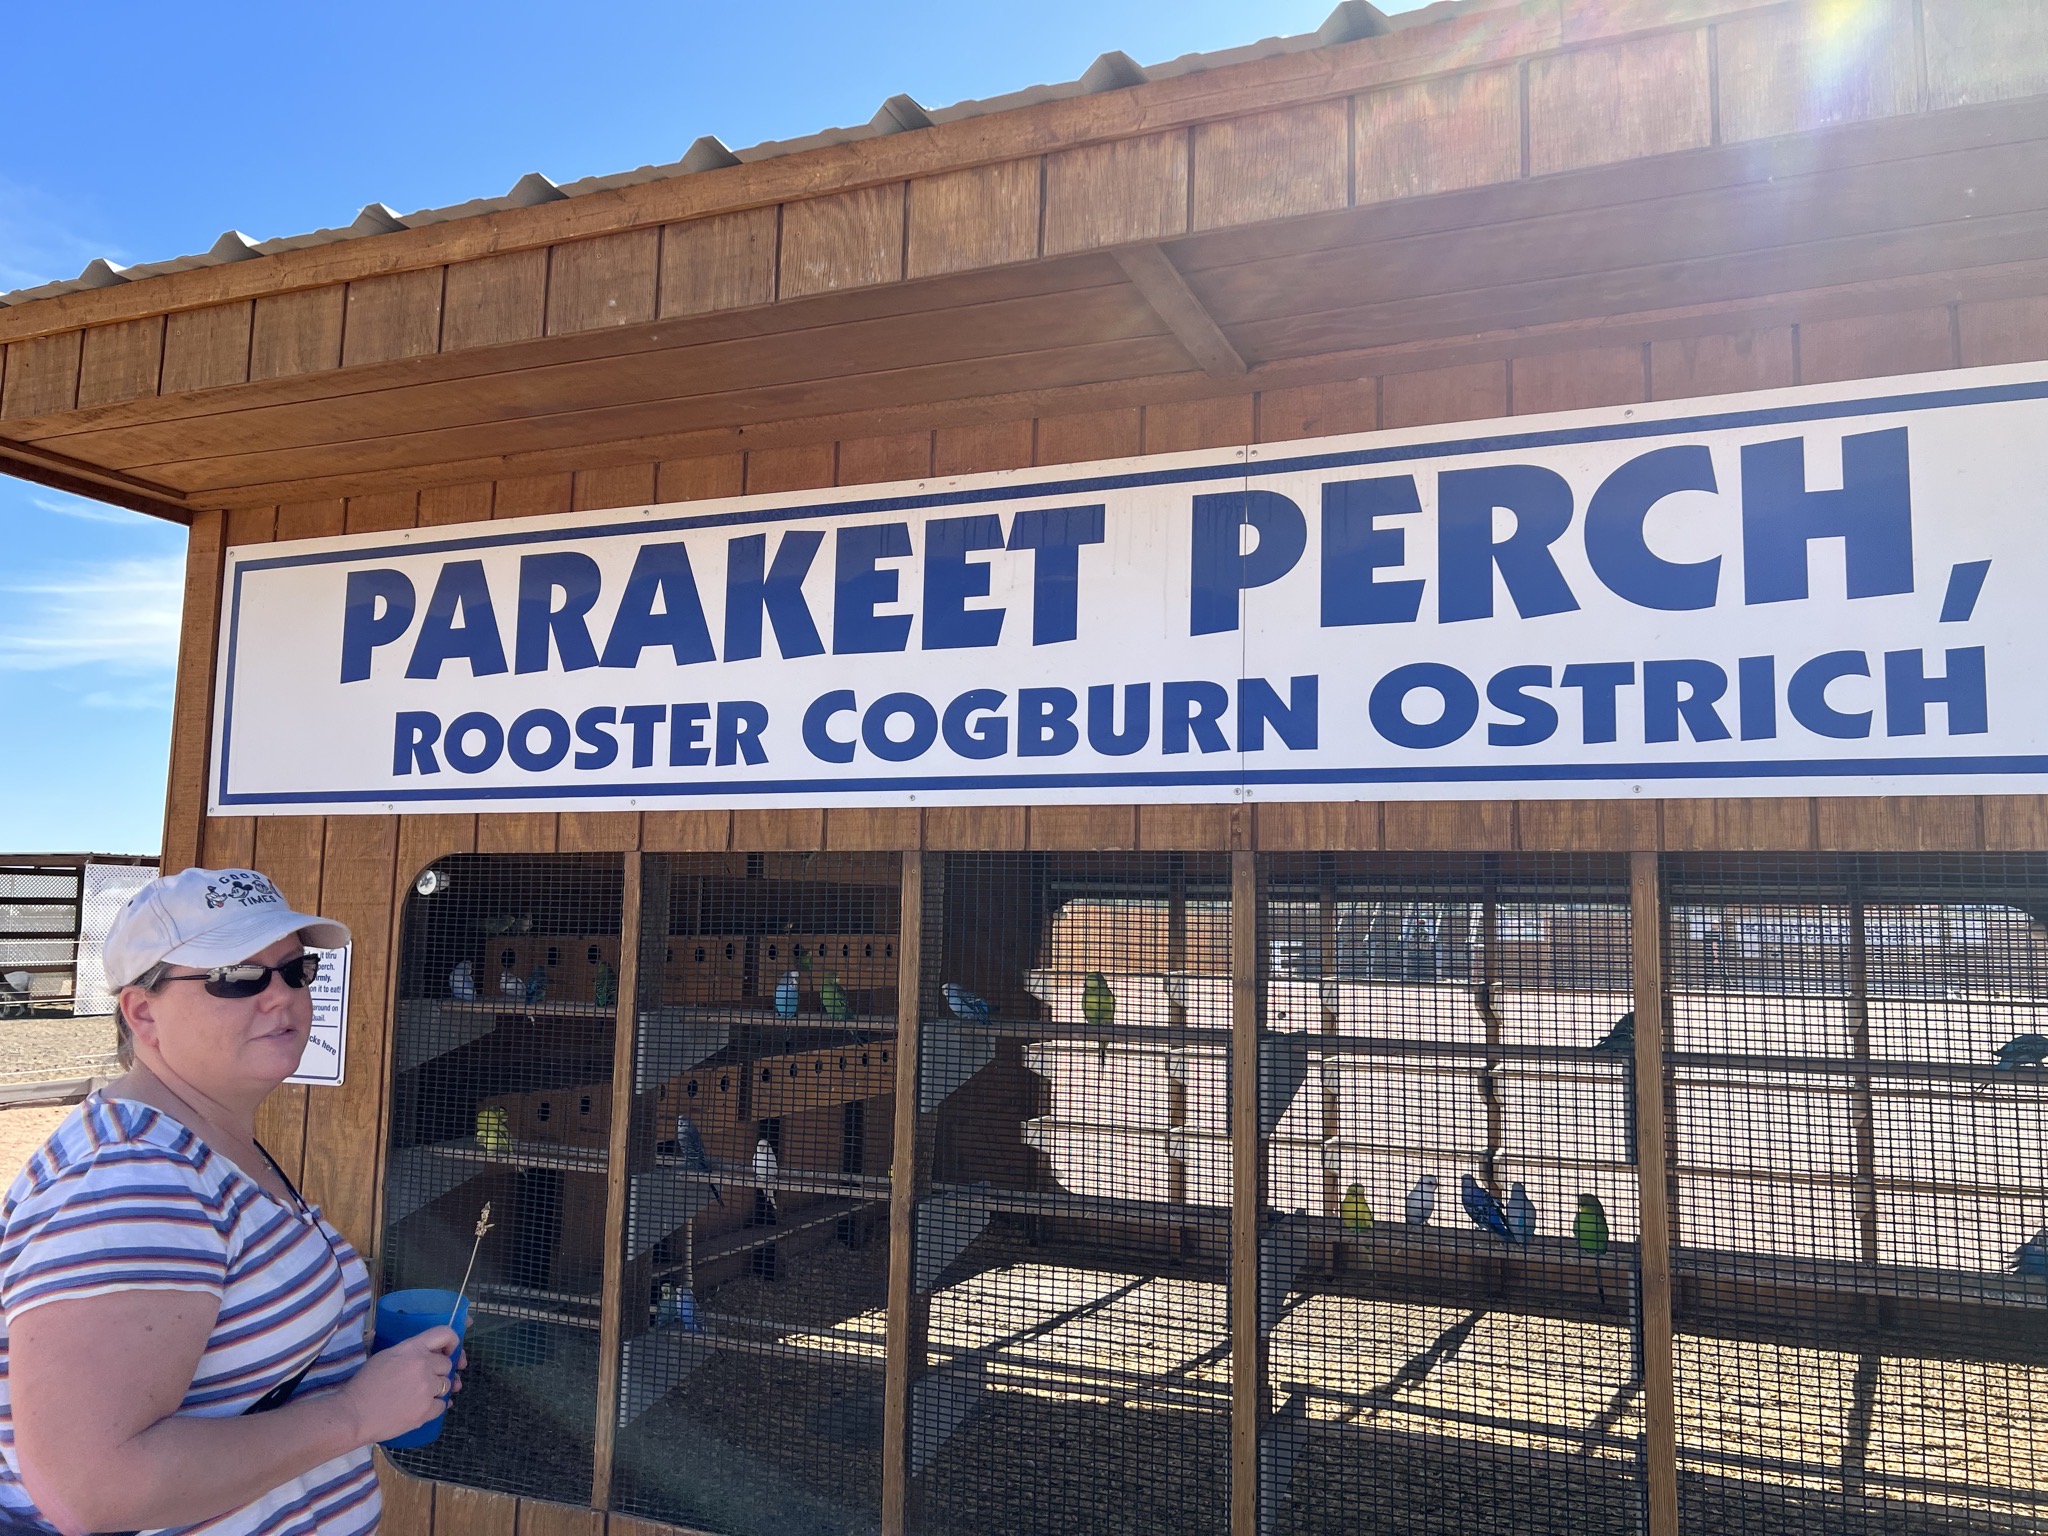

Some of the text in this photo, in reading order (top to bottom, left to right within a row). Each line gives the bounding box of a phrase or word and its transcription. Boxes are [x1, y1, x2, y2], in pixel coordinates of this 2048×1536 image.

[341, 427, 1993, 684] PARAKEET PERCH,
[394, 645, 1990, 776] ROOSTER COGBURN OSTRICH
[218, 872, 259, 883] GOOD
[237, 894, 277, 906] TIMES
[325, 951, 337, 960] thru
[315, 974, 332, 983] irmly.
[323, 985, 329, 993] to
[321, 1040, 336, 1056] here
